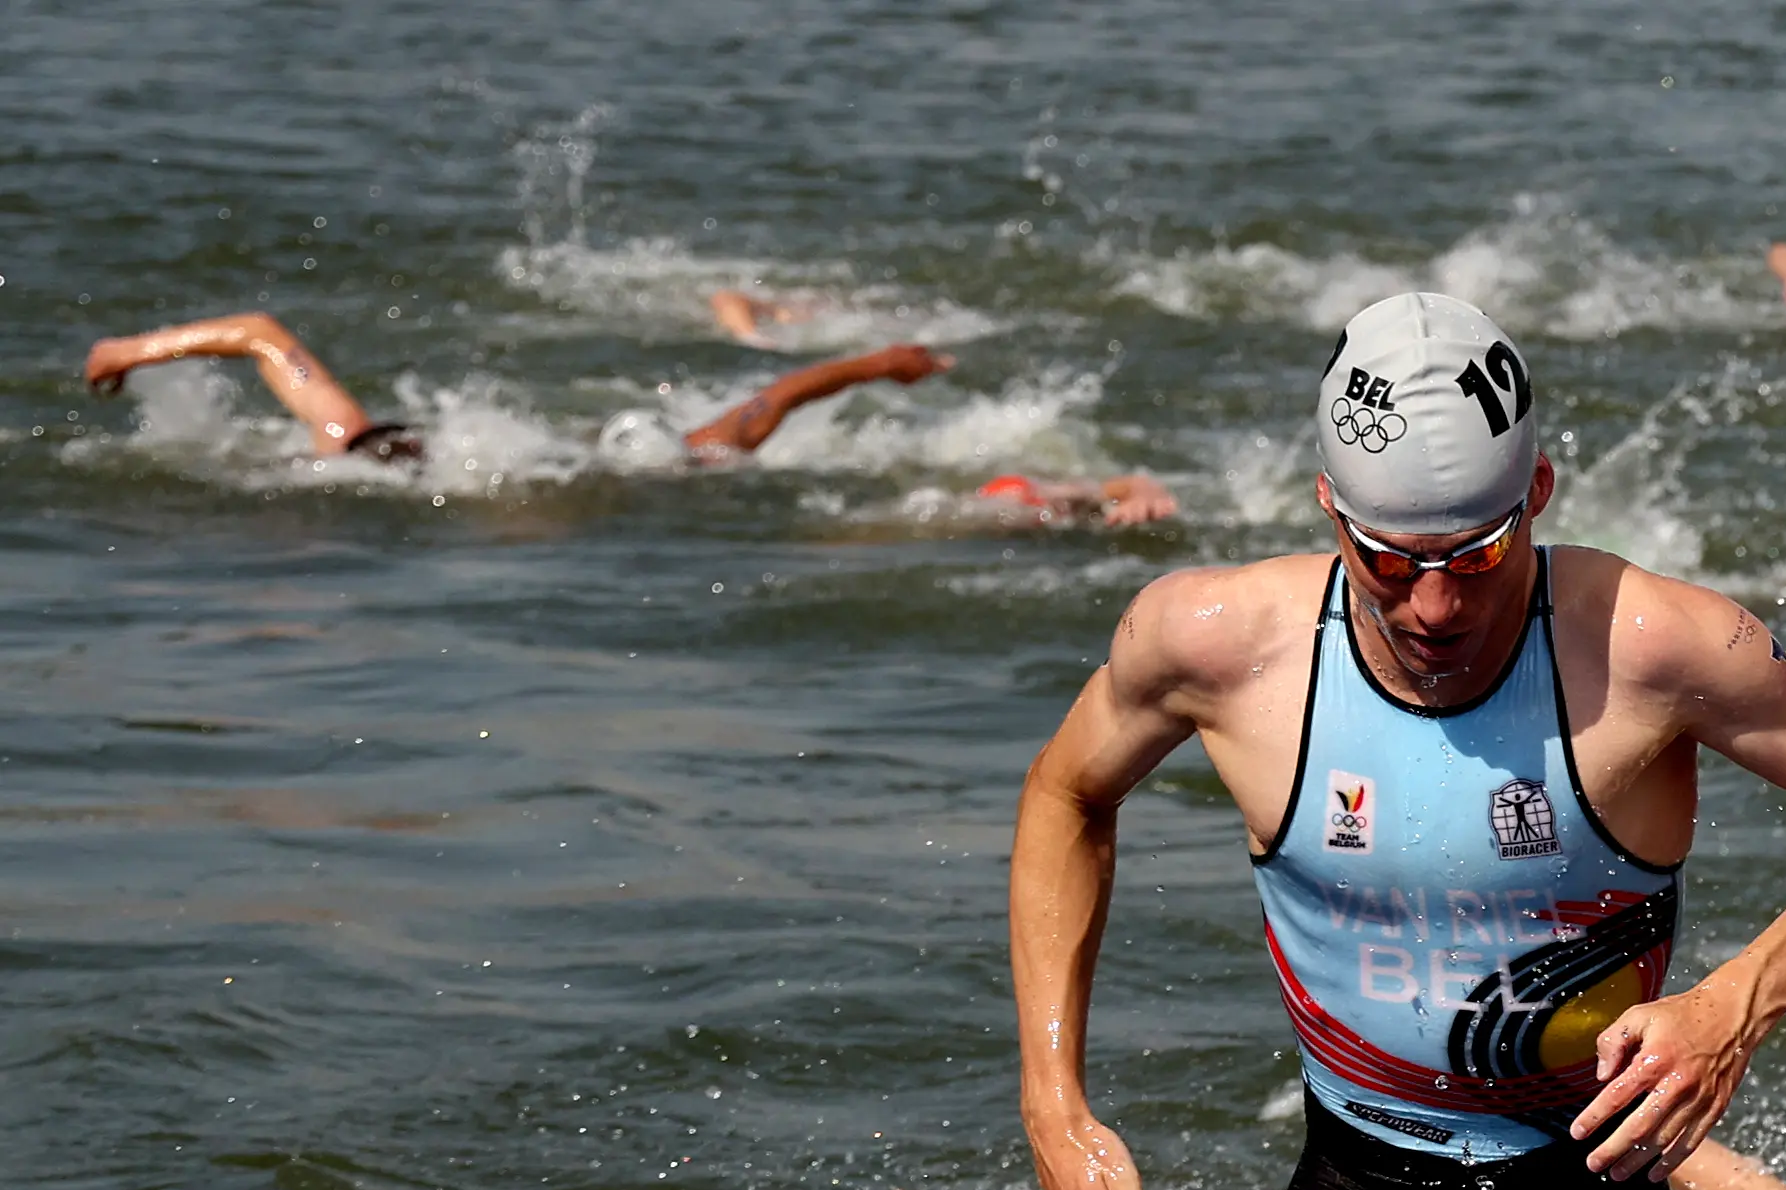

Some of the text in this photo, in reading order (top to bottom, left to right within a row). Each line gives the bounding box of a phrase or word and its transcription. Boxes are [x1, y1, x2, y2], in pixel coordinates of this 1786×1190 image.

[1345, 366, 1396, 411] BEL
[1328, 840, 1367, 850] BELGIUM
[1336, 832, 1360, 842] TEAM
[1502, 841, 1559, 858] BIORACER
[1317, 880, 1582, 947] VAN RIEL
[1358, 942, 1555, 1014] BEL
